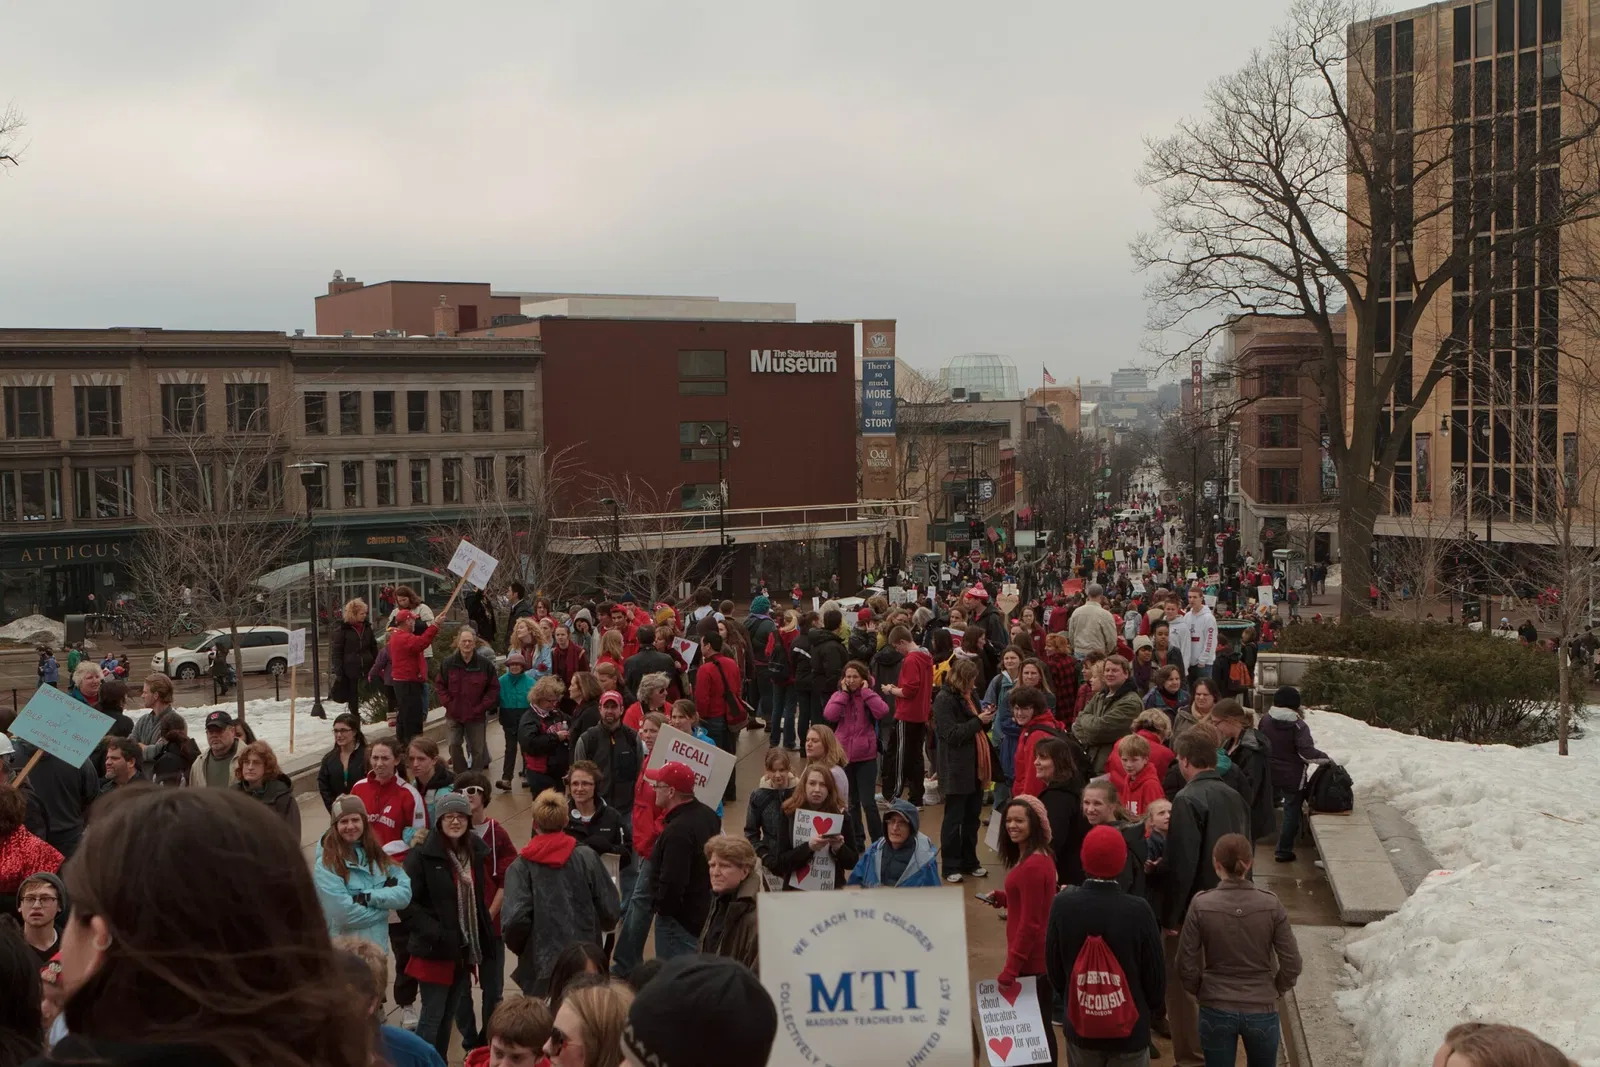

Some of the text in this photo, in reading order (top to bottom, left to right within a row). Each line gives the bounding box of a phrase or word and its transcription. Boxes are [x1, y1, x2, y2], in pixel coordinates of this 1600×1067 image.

[772, 349, 837, 358] The State Historical
[750, 350, 837, 373] Museum
[866, 362, 891, 370] There's
[866, 389, 892, 399] MORE
[865, 418, 893, 428] STORY
[870, 449, 888, 458] Odd
[984, 480, 992, 498] 100
[1204, 481, 1212, 498] 100
[366, 536, 396, 545] camera
[20, 542, 121, 562] ATTICUS
[672, 740, 710, 767] RECALL
[797, 810, 810, 823] Care
[796, 824, 812, 837] about
[816, 856, 828, 866] care
[810, 867, 832, 880] for your
[792, 908, 934, 956] WE TEACH THE CHILDREN
[806, 969, 922, 1014] MTI
[979, 983, 994, 995] Care
[980, 996, 1000, 1010] about
[780, 982, 821, 1065] COLLECTIVELY
[806, 1015, 928, 1028] MADISON TEACHERS INC.
[906, 976, 952, 1067] UNITED WE ACT
[983, 1010, 1018, 1024] educators
[986, 1022, 1032, 1036] like they care
[1014, 1036, 1041, 1048] for your
[1031, 1047, 1049, 1061] child
